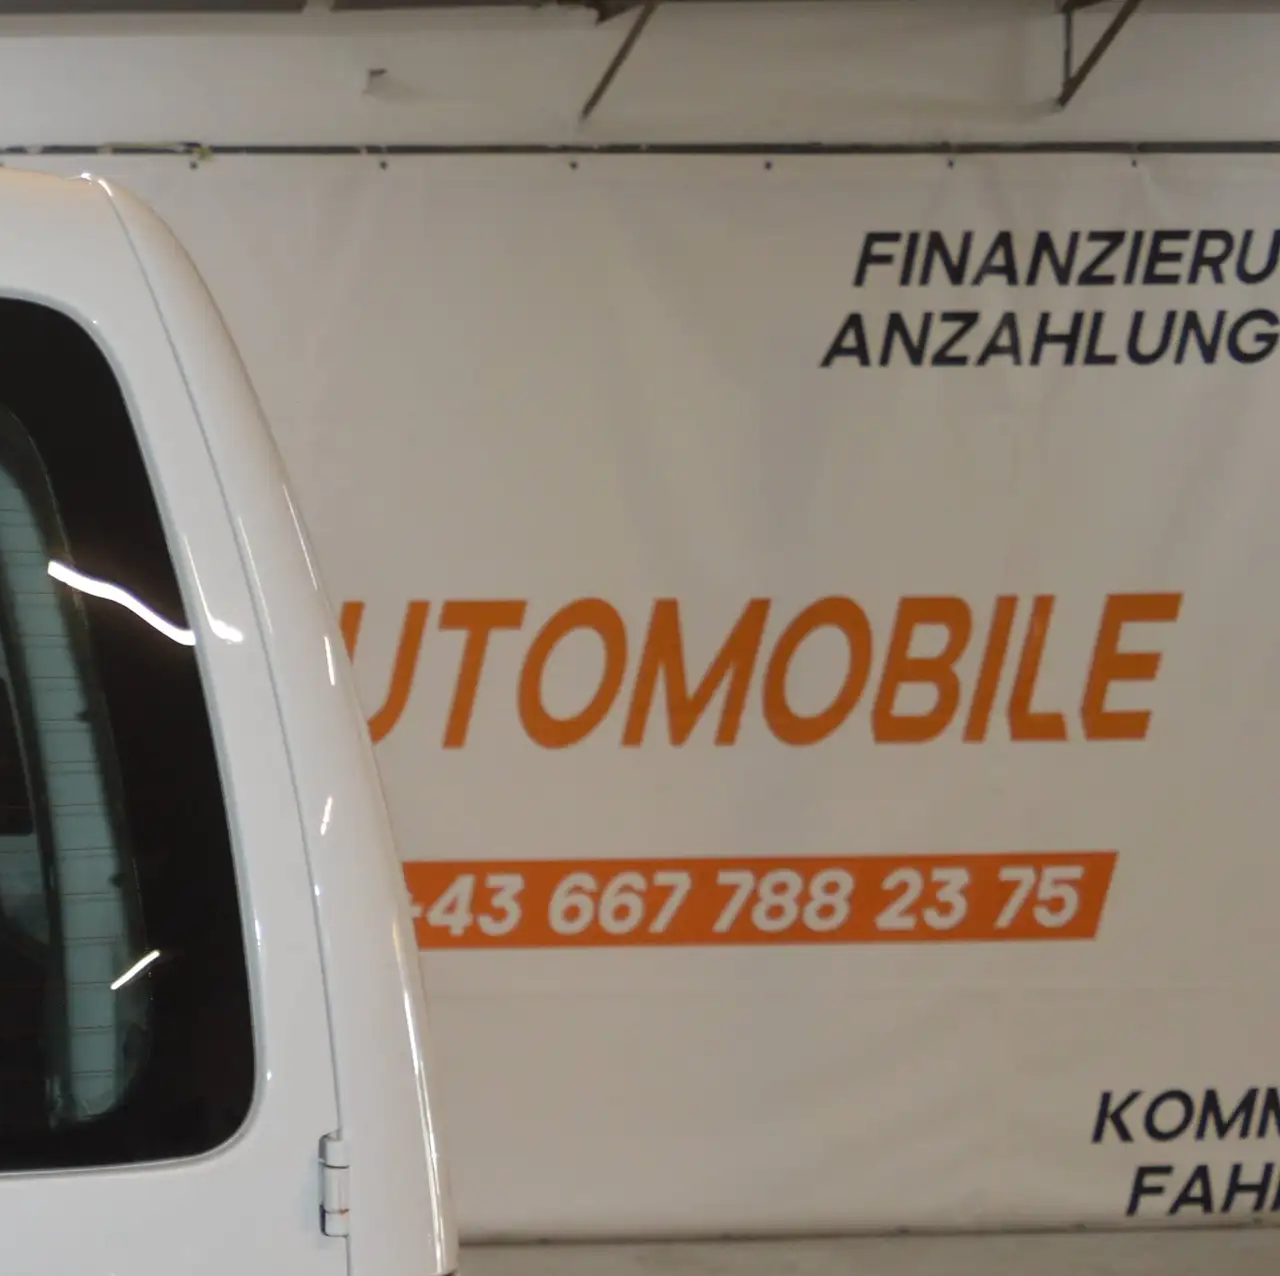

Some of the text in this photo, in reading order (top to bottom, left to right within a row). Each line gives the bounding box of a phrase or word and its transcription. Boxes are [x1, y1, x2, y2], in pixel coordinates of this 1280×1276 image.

[852, 229, 1280, 287] FINANZIERU
[820, 308, 1280, 367] ANZAHLUNG
[547, 870, 692, 935] 667
[711, 868, 855, 933] 788
[874, 867, 971, 931] 23
[993, 865, 1085, 929] 75
[1126, 1162, 1280, 1216] FAH
